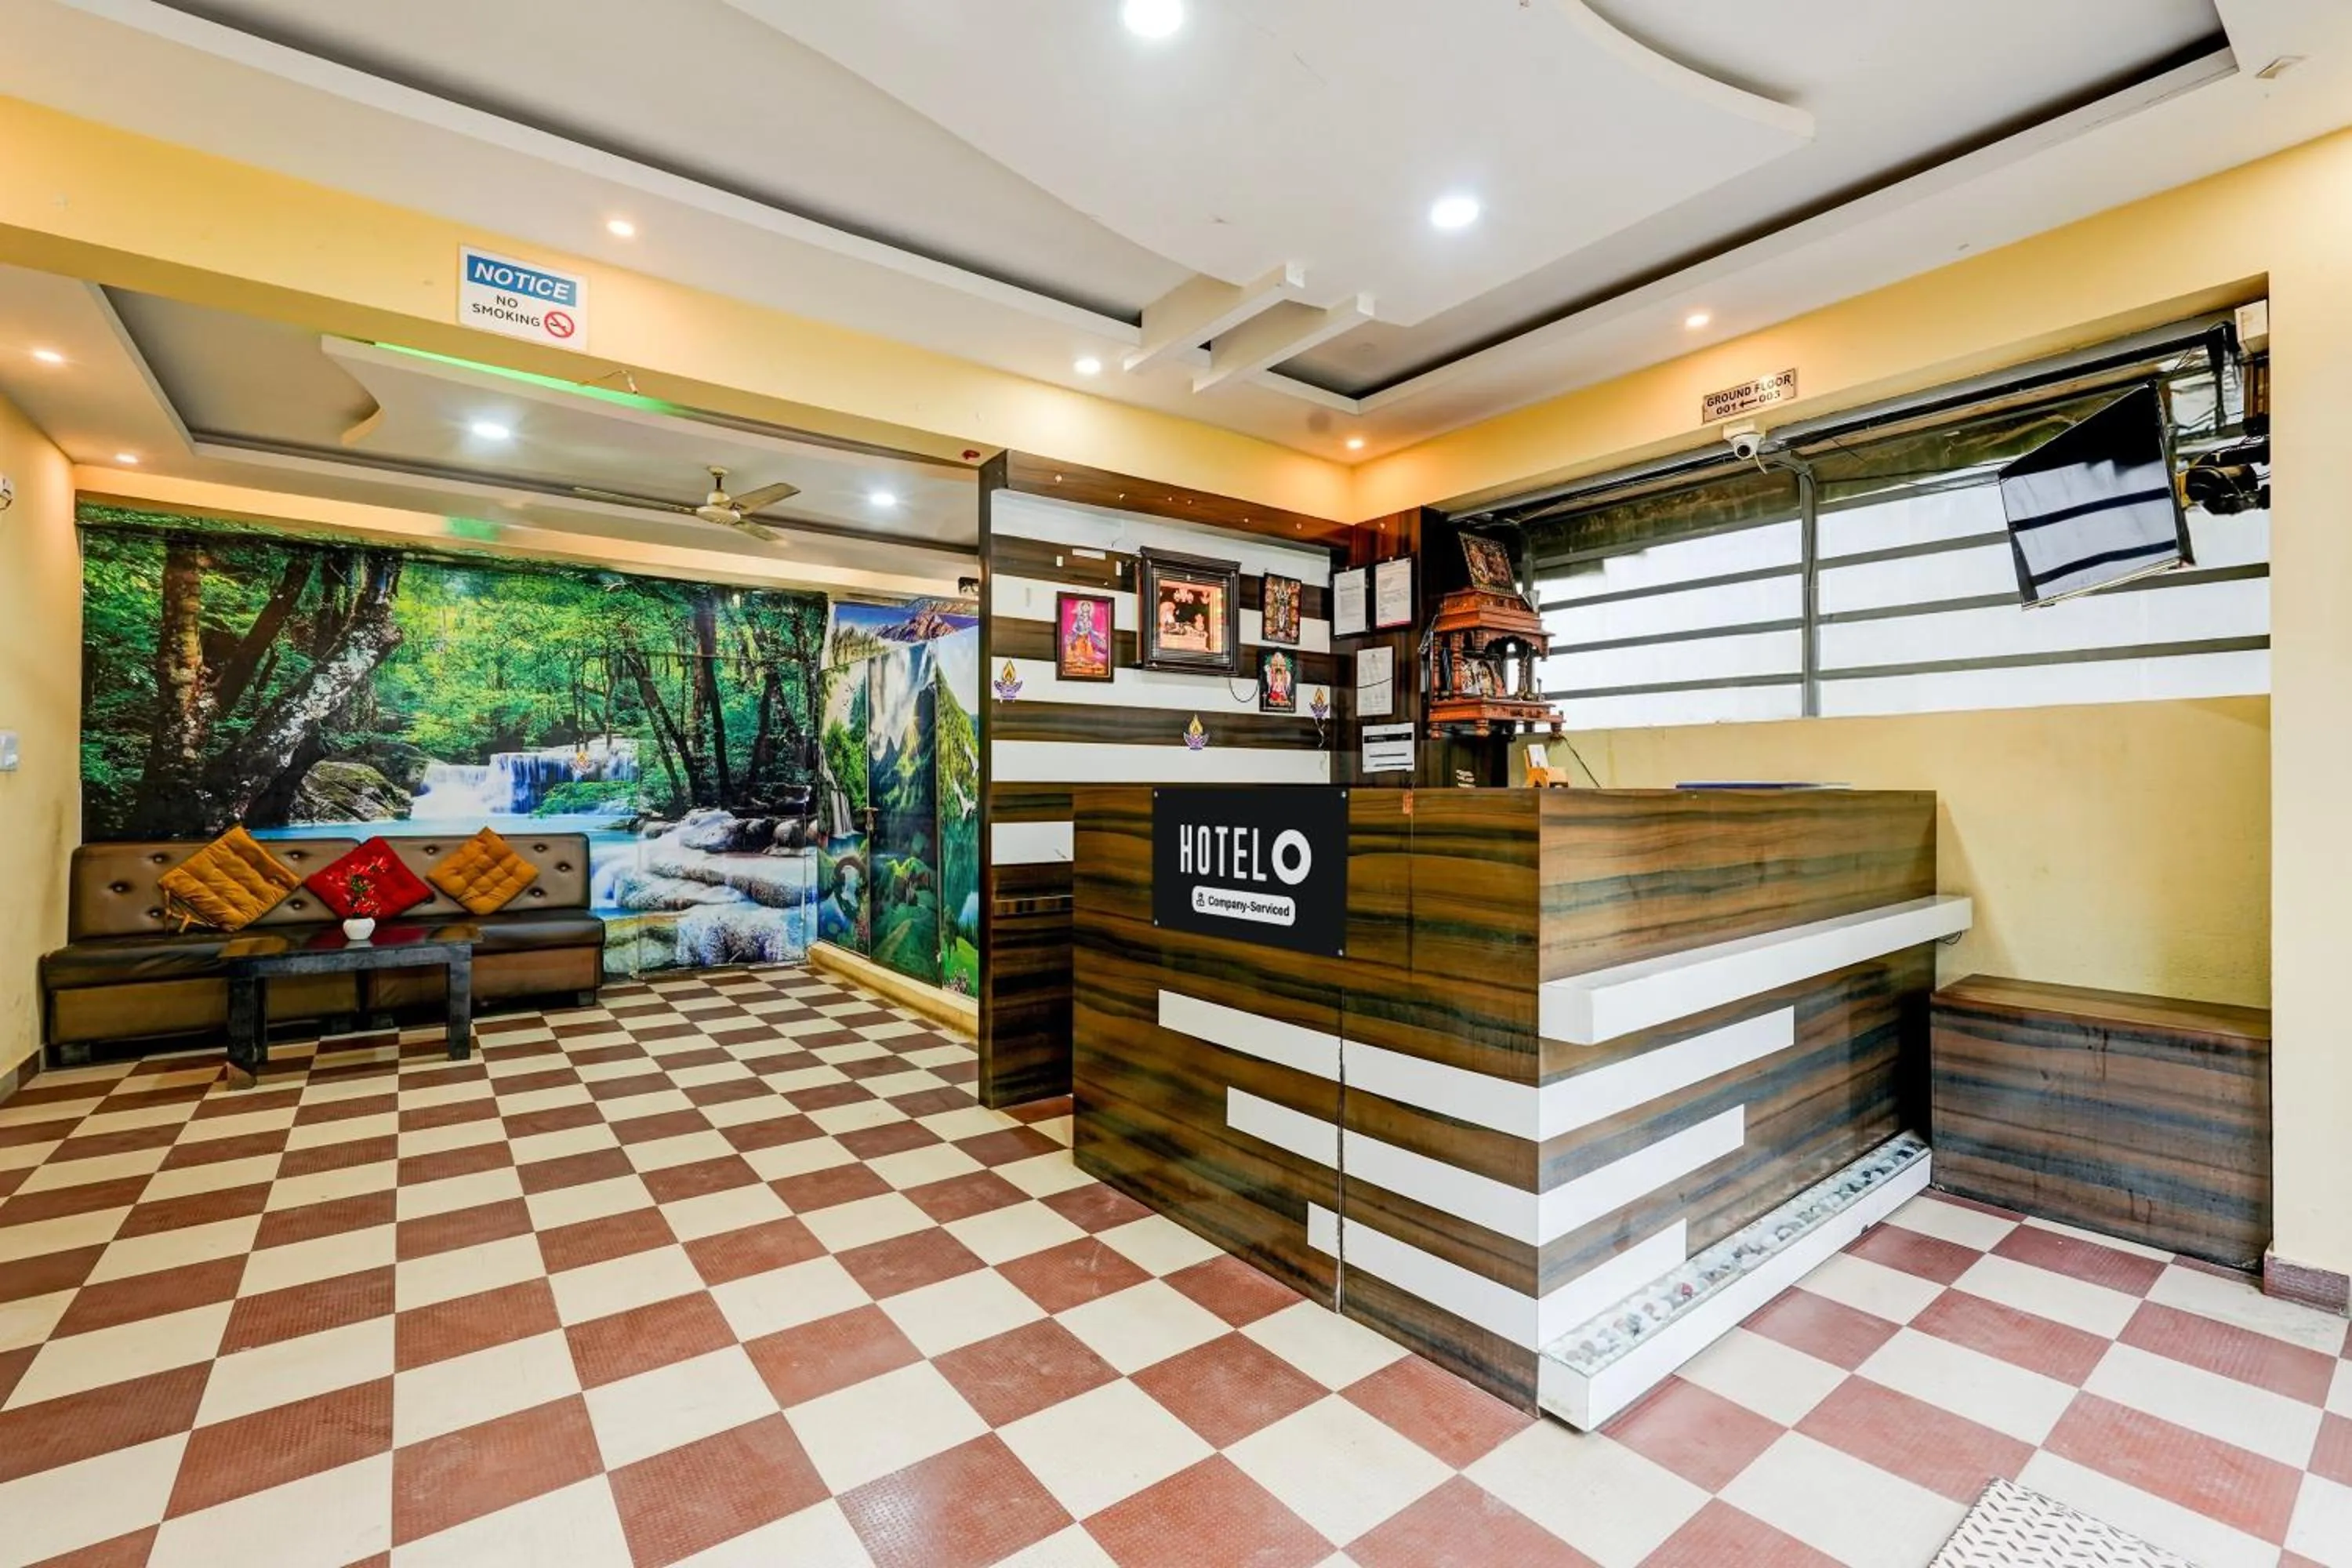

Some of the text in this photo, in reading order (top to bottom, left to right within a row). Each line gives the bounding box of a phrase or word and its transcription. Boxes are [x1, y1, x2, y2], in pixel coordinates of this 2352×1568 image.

[474, 263, 570, 300] NOTICE
[496, 295, 518, 308] NO
[472, 303, 541, 327] SMOKING
[1707, 374, 1791, 407] GROUND FLOOR
[1716, 402, 1737, 415] 001
[1180, 824, 1312, 885] HOTEL O
[1208, 895, 1290, 917] Company-Serviced
